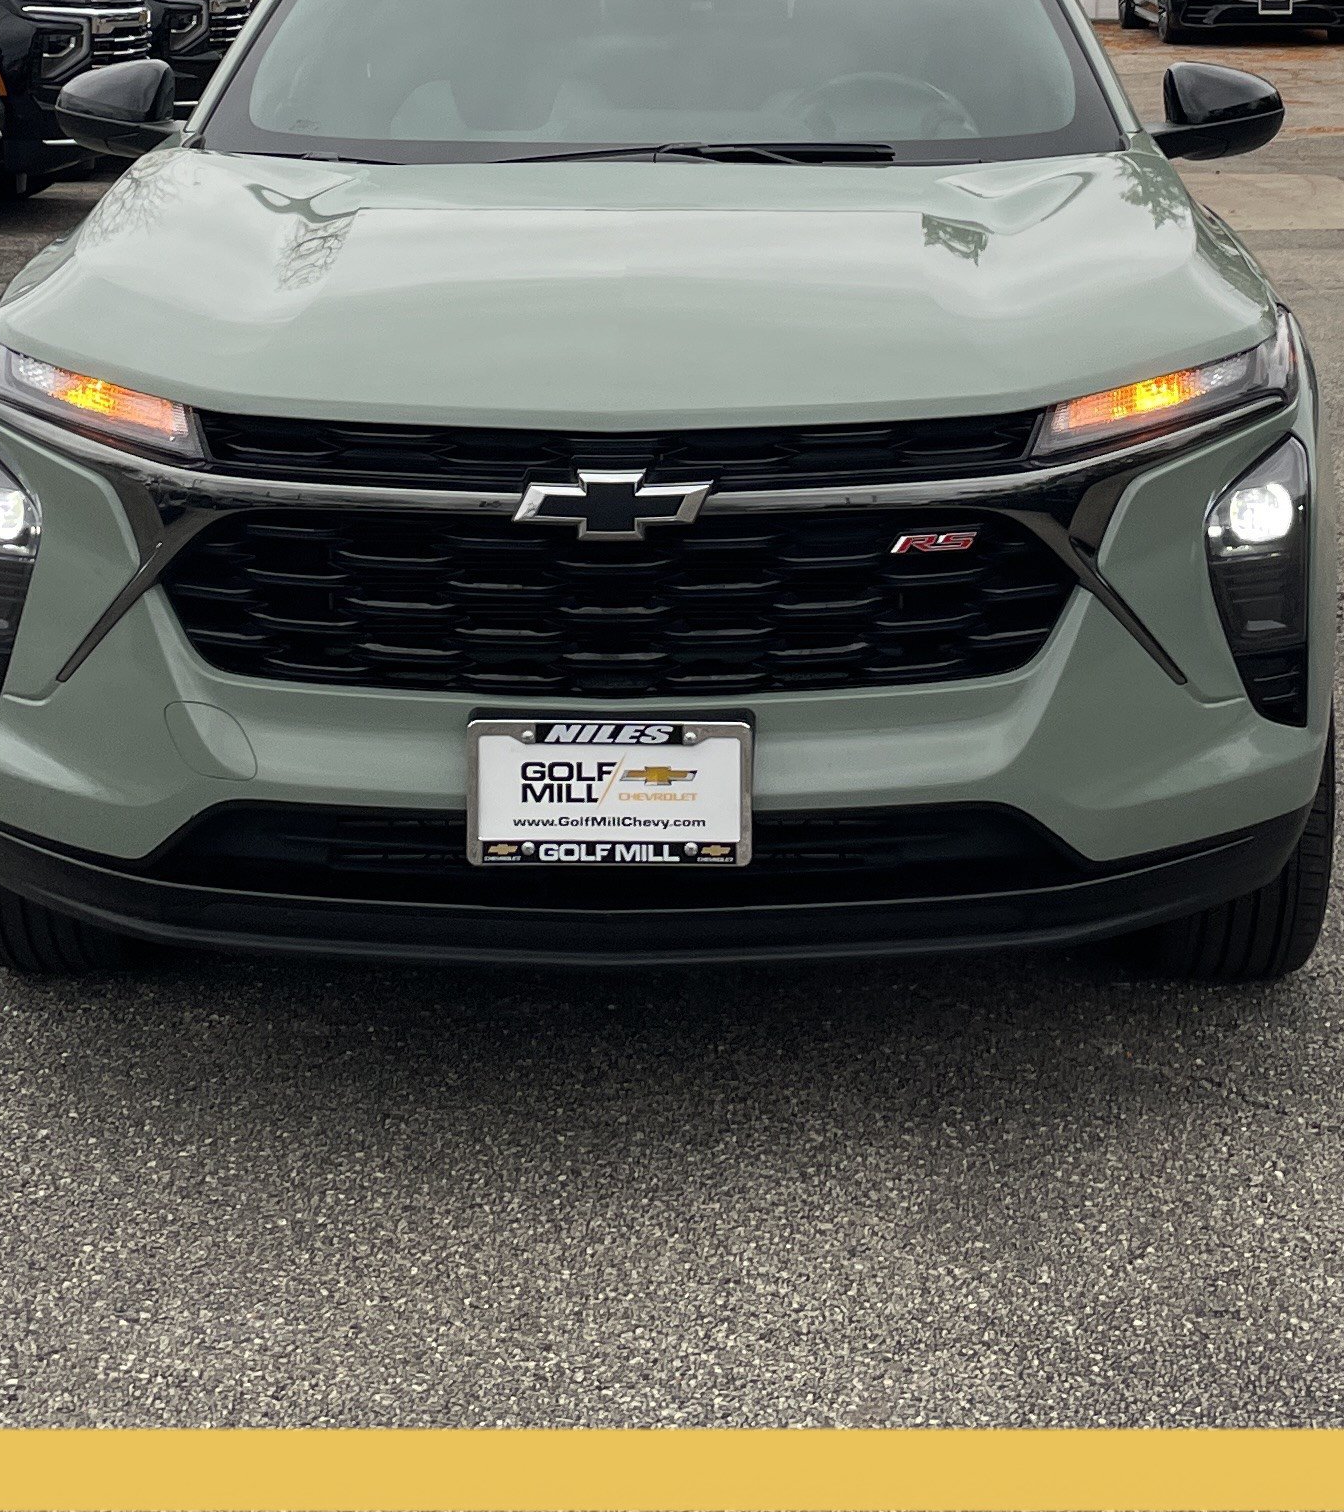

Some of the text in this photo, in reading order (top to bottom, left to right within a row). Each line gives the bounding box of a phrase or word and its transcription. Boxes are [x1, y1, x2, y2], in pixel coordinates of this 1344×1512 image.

[890, 532, 977, 553] RS
[544, 725, 673, 744] NILES
[521, 761, 618, 782] GOLF
[521, 783, 599, 803] MILL
[618, 792, 698, 801] CHEVROLET
[513, 816, 706, 829] www.GolfMillChevy.com
[538, 844, 680, 862] GOLF MILL
